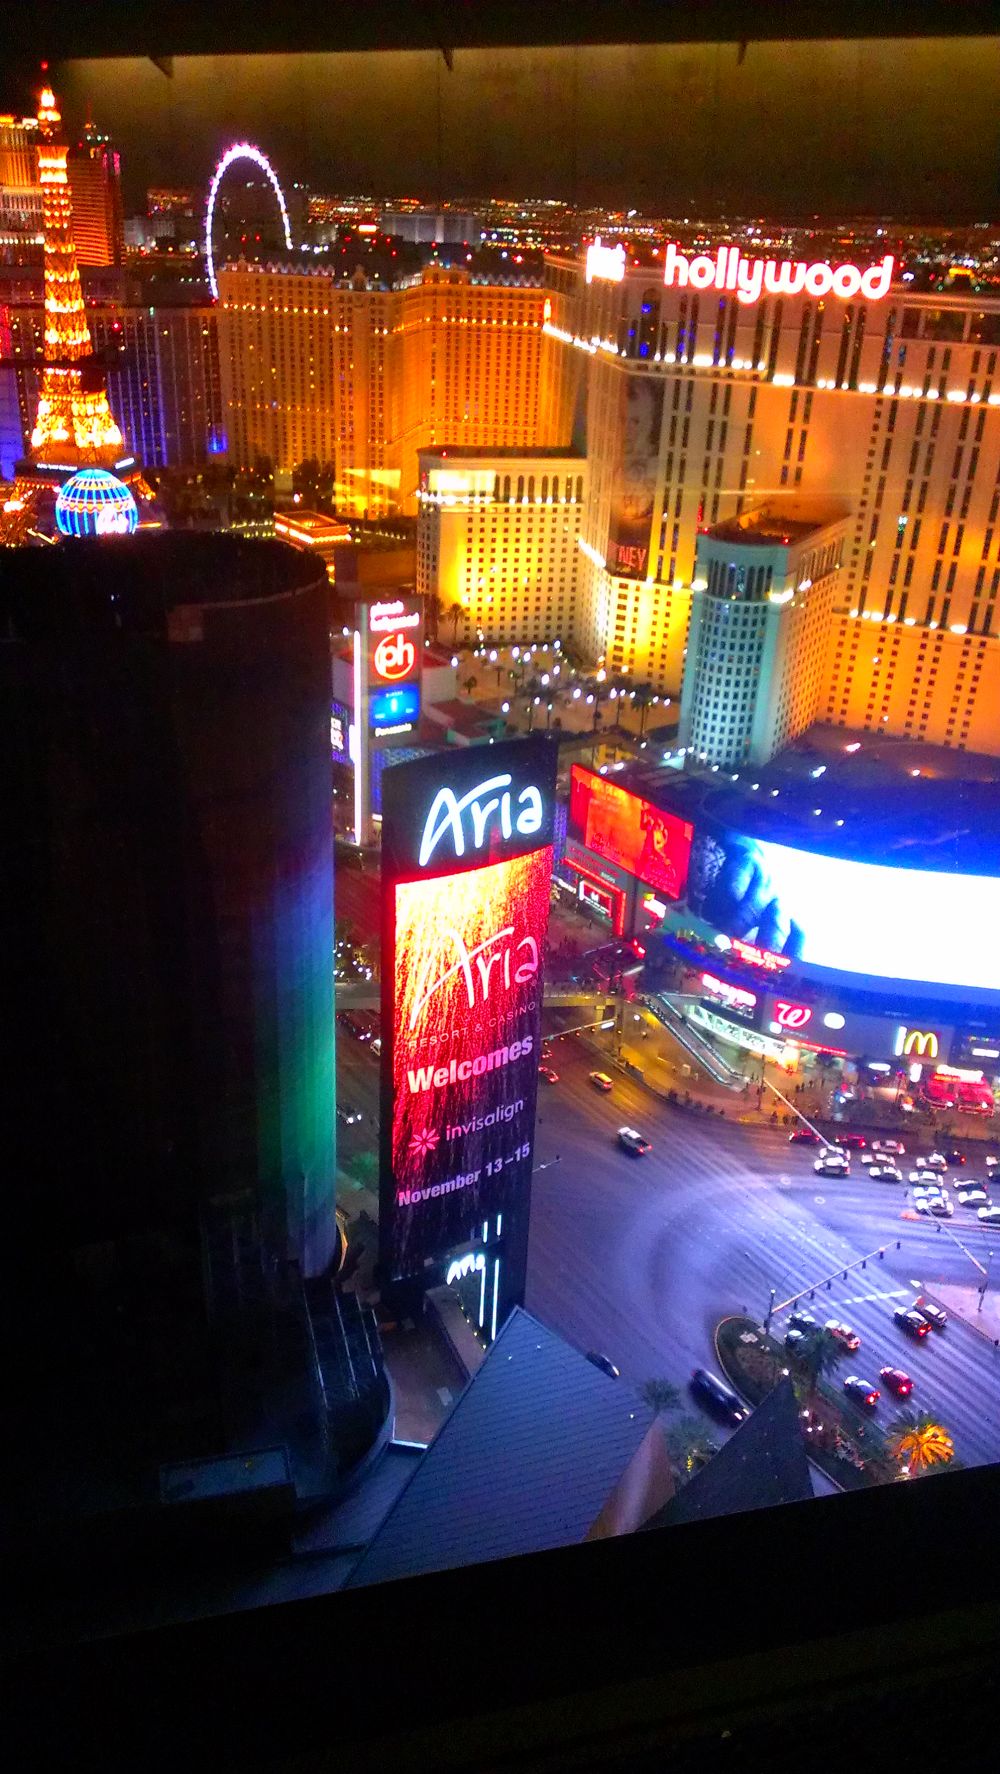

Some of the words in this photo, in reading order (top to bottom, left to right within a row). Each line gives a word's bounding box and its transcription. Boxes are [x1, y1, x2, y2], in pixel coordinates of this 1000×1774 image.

[664, 244, 894, 304] hollywood
[418, 773, 544, 867] Aria
[409, 927, 539, 1030] Aria
[408, 1028, 469, 1050] RESORT
[475, 1022, 484, 1034] &
[488, 1001, 537, 1028] CASINO
[408, 1034, 533, 1095] Welcomes
[446, 1099, 525, 1142] invisalign
[398, 1167, 482, 1207] November
